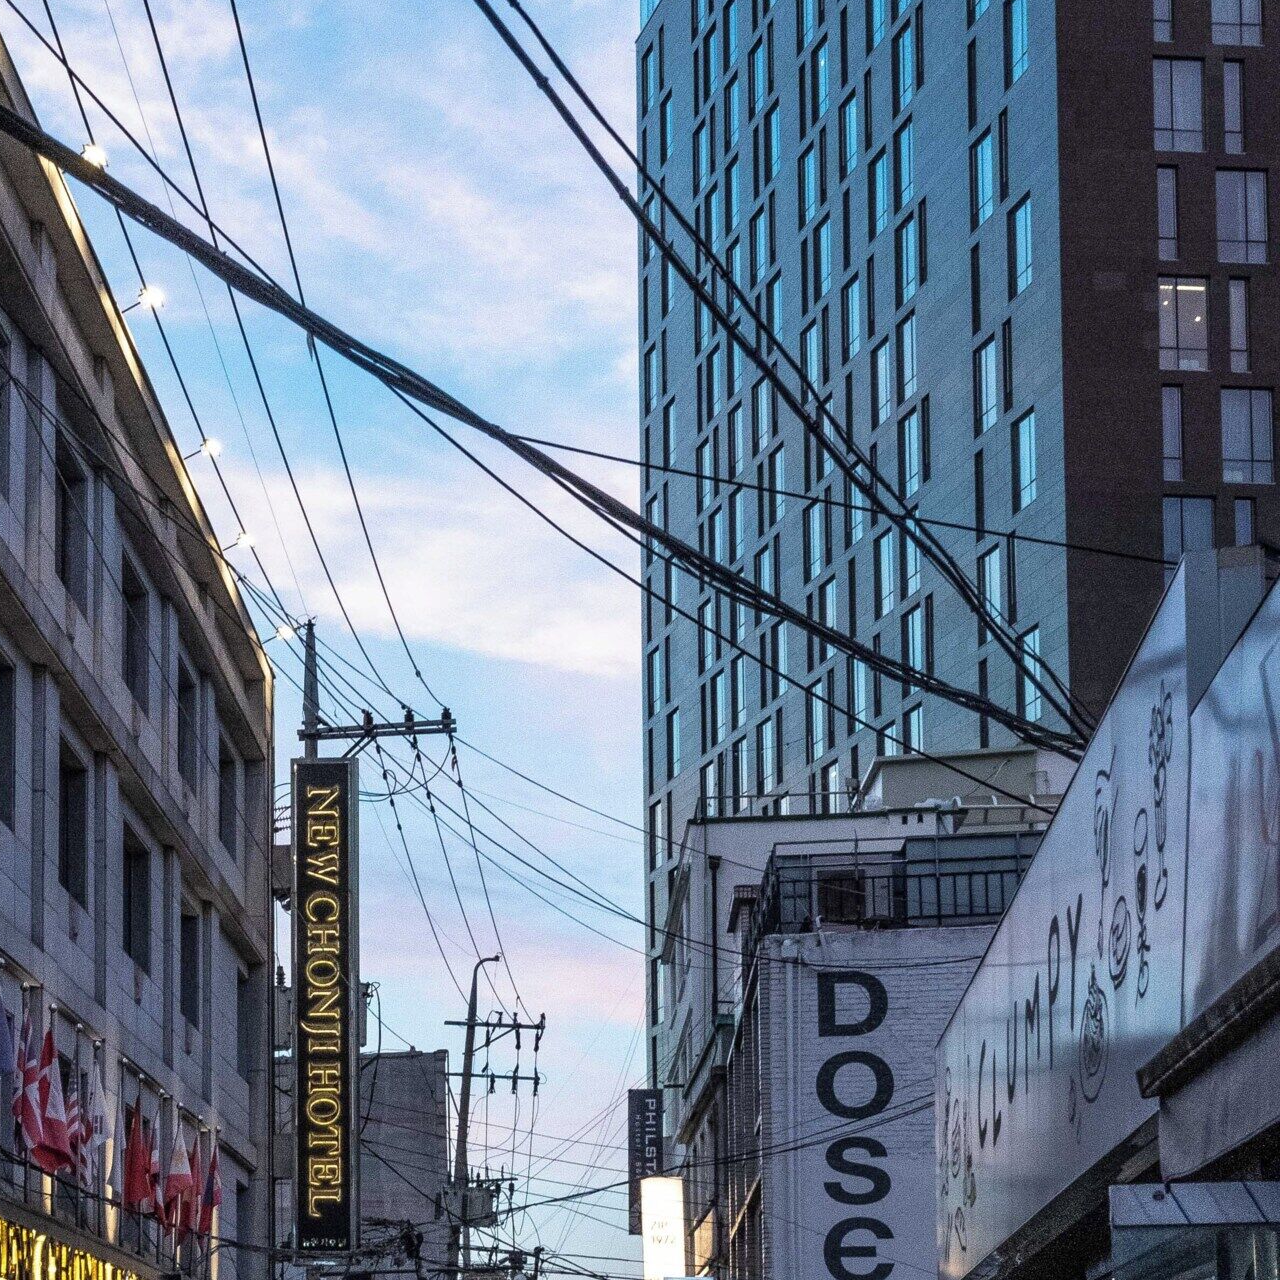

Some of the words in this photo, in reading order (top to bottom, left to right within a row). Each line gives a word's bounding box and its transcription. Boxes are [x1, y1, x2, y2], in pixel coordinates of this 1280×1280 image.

[306, 785, 340, 886] NEW
[304, 897, 340, 1051] CHONJI
[977, 893, 1083, 1151] CLUMPY
[306, 1061, 344, 1219] HOTEL
